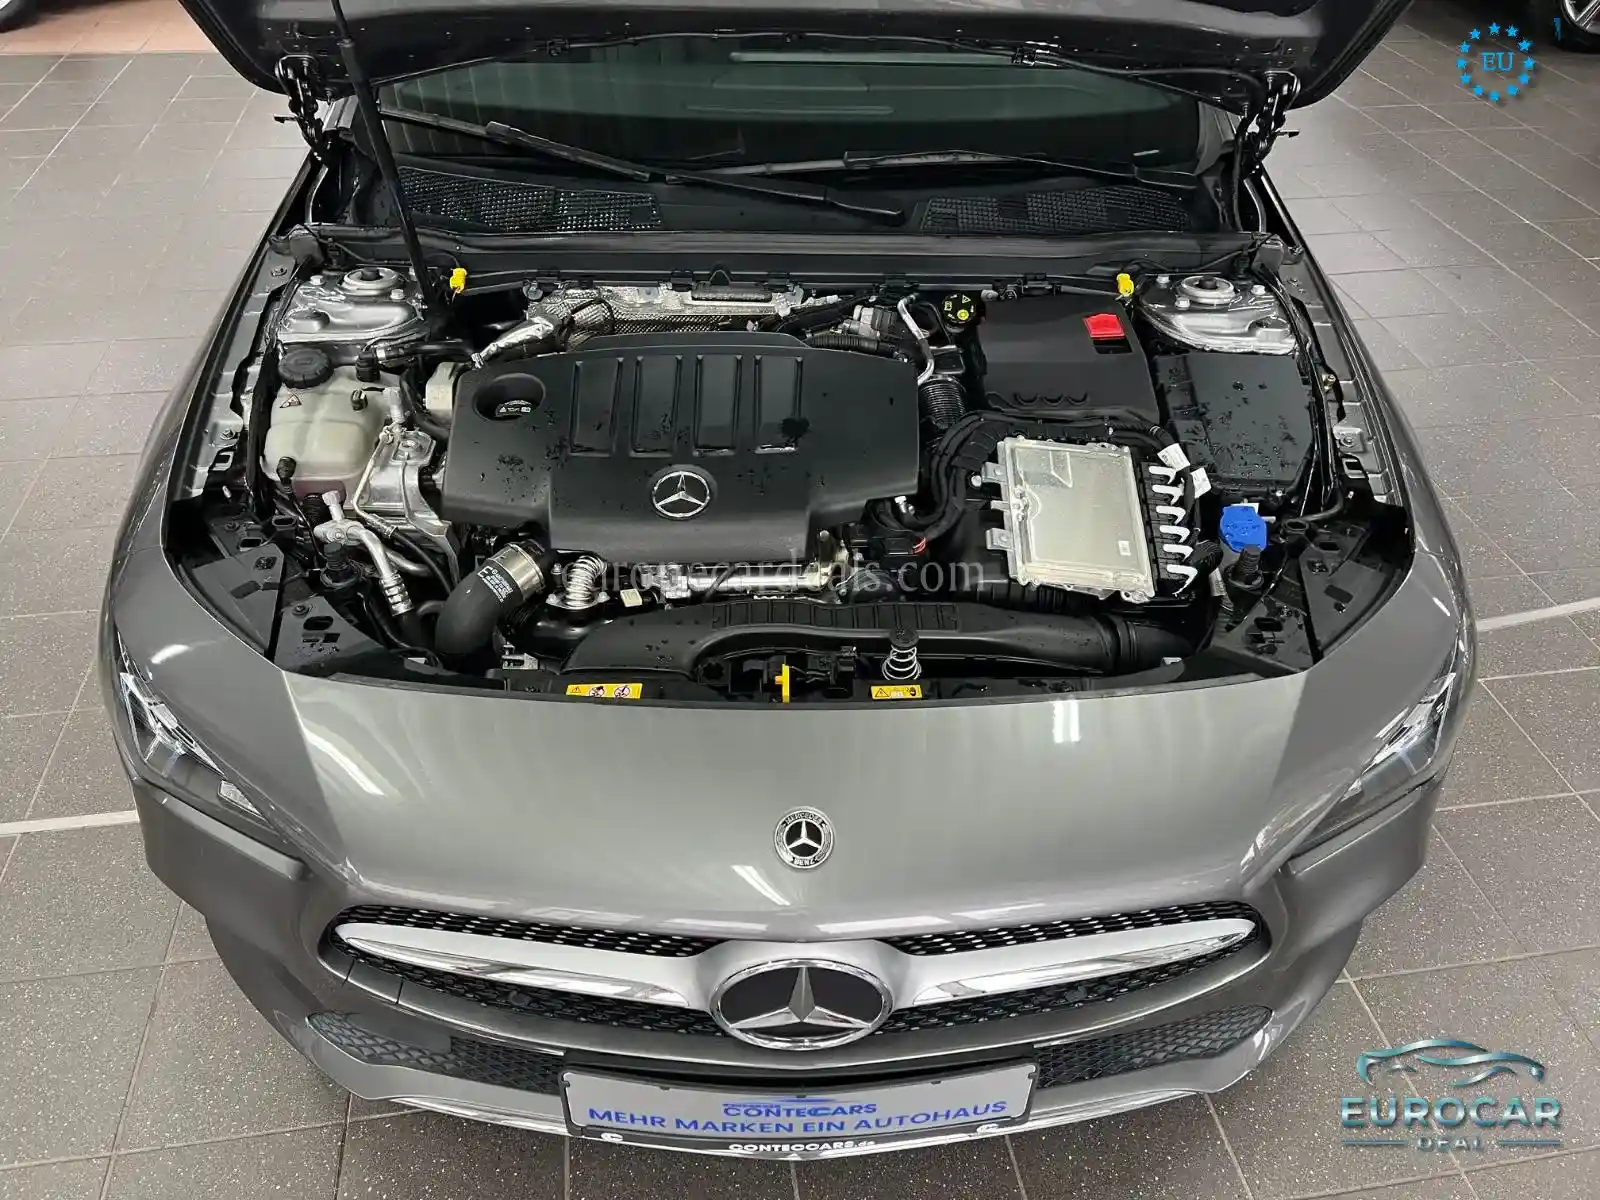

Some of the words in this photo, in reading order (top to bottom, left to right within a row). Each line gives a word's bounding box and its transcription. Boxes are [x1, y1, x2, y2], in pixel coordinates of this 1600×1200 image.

[589, 1108, 667, 1128] MEHR
[675, 1118, 794, 1133] MARKEN
[803, 1120, 845, 1133] EIN
[854, 1101, 1007, 1130] AUTOHAUS
